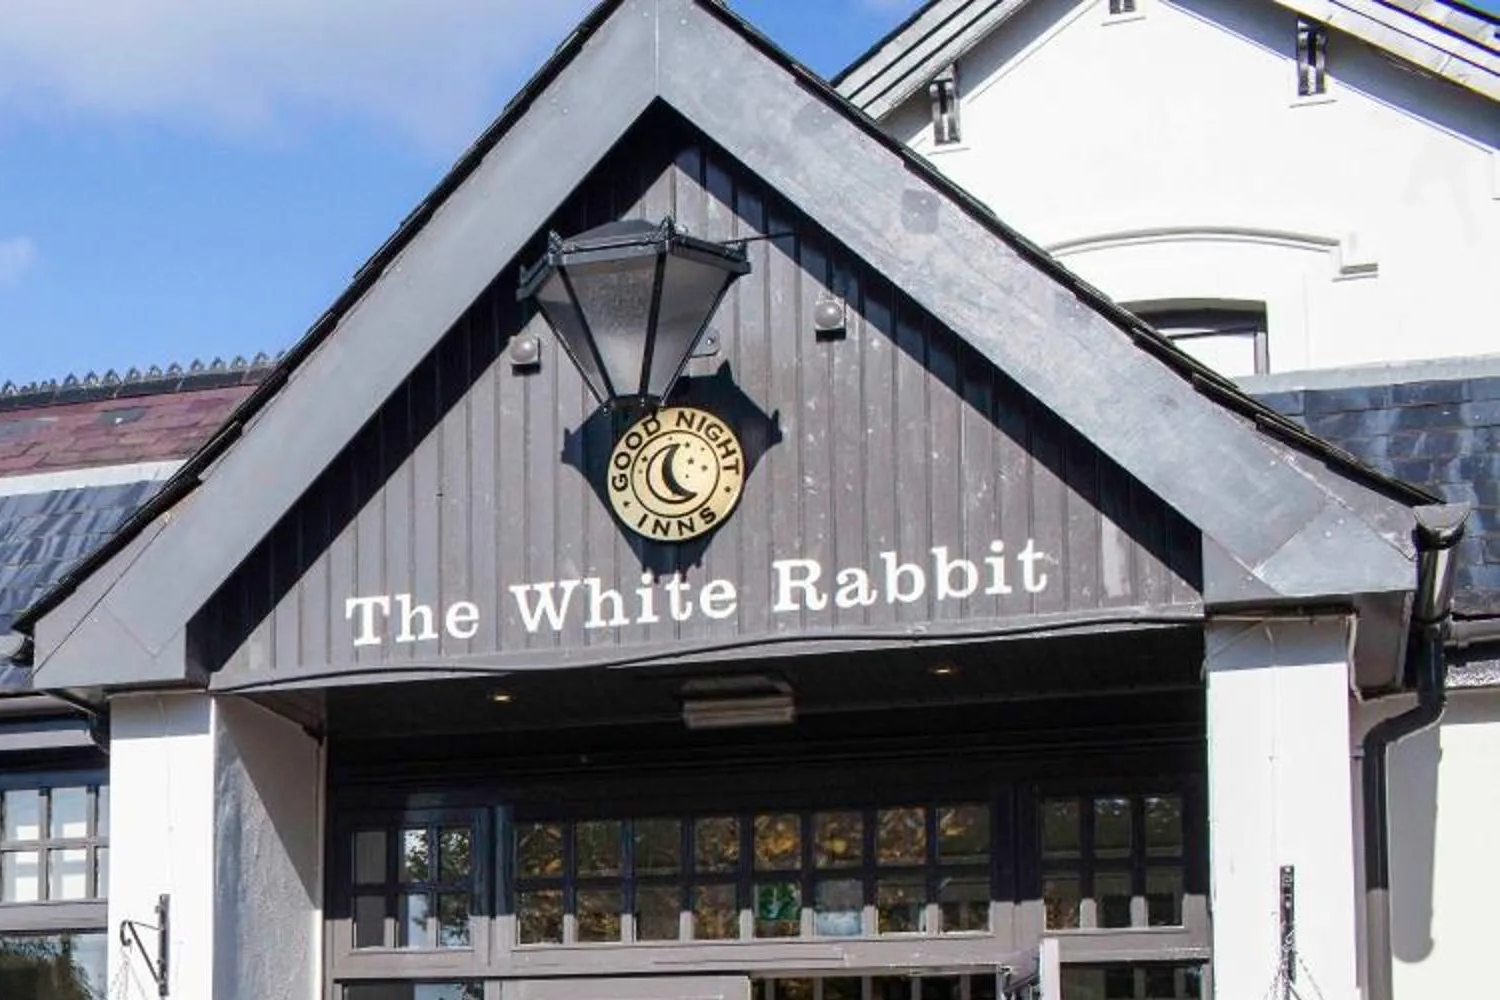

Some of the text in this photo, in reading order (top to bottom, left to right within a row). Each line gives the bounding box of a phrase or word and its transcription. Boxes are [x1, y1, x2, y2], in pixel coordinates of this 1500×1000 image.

[611, 410, 741, 492] GOOD NIGHT
[637, 506, 717, 536] INNS
[345, 538, 1048, 646] The White Rabbit
